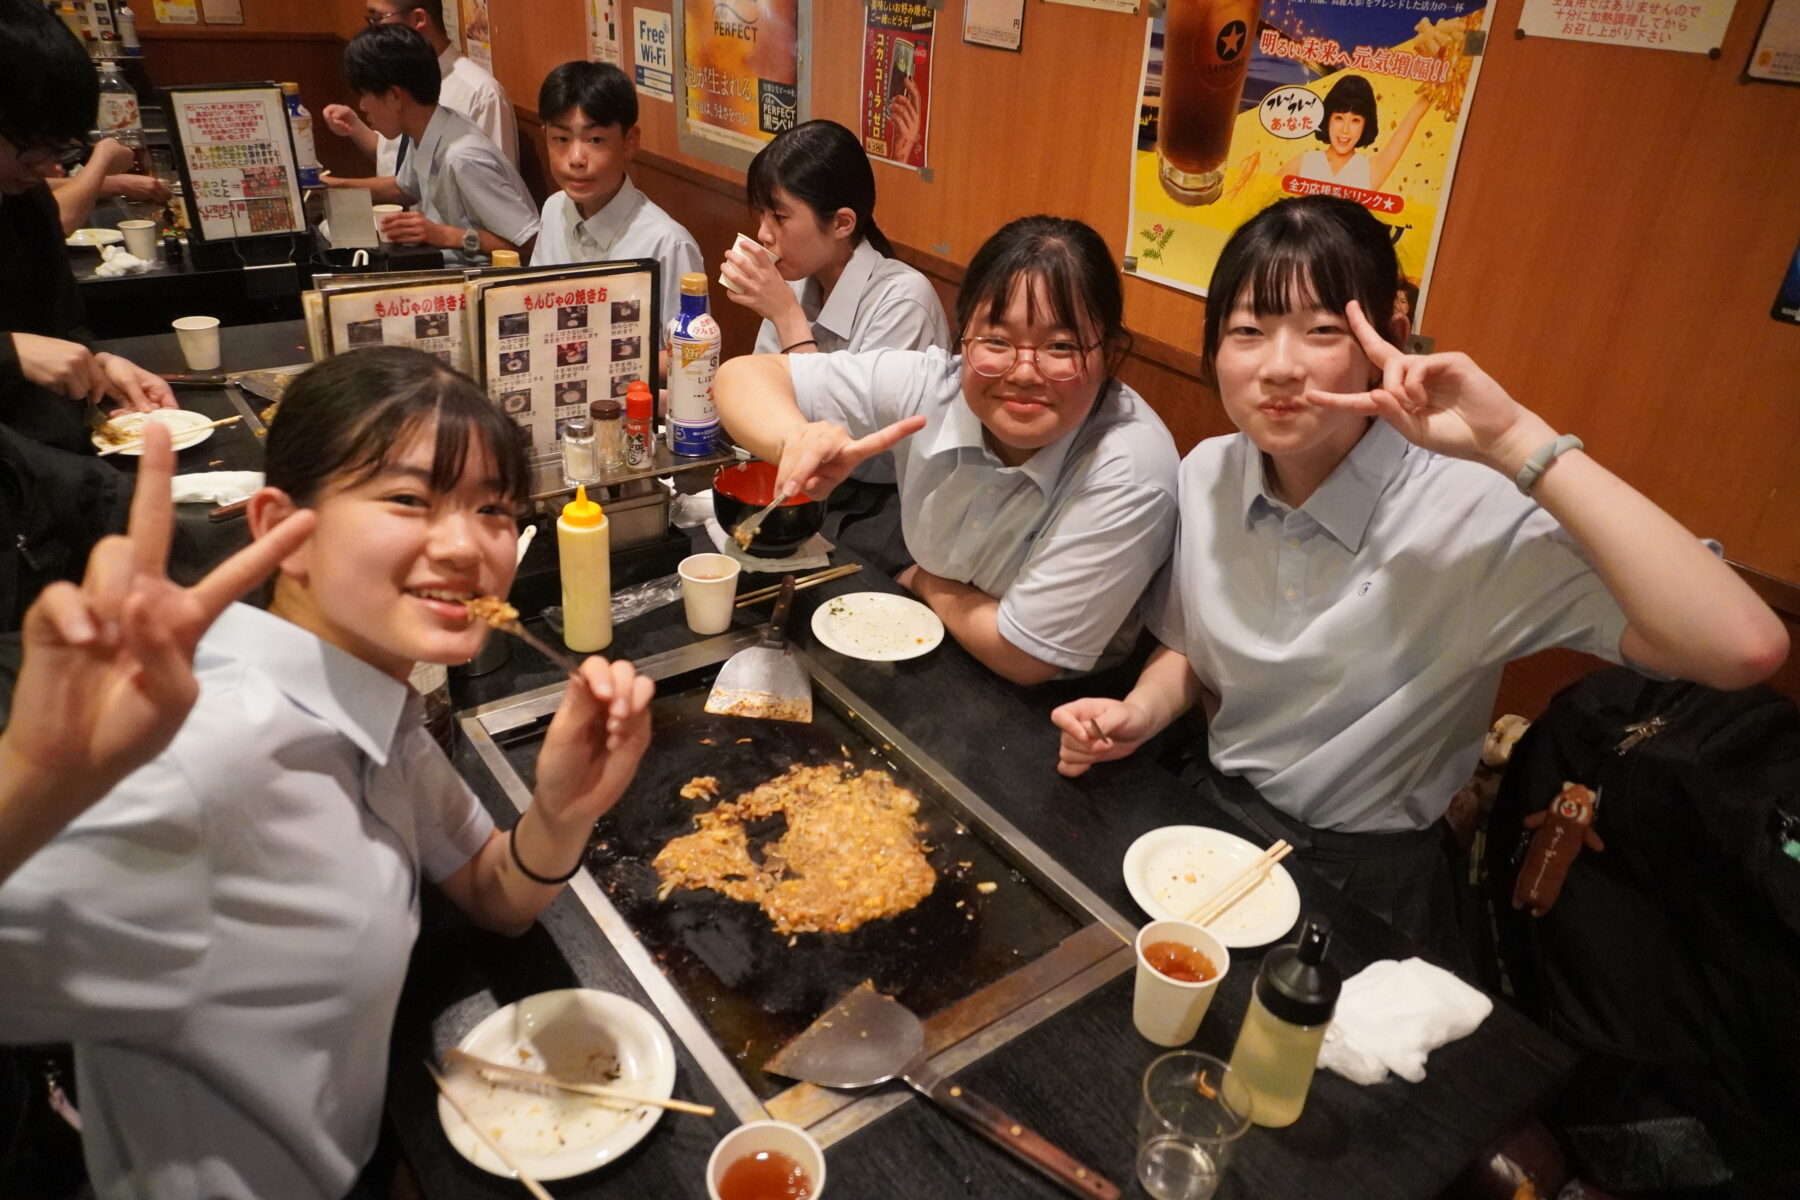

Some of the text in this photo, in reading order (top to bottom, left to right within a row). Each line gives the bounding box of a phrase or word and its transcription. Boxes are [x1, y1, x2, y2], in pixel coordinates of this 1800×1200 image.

[640, 20, 665, 45] Free
[714, 21, 758, 42] PERFECT
[1554, 10, 1687, 32] 十分に加熱調理してから
[1561, 22, 1672, 43] お召し上がり下さい
[640, 43, 666, 66] Wi-Fi
[1259, 28, 1450, 83] 明るい未来へ元気増幅!!
[873, 34, 884, 138] コカ・コーラ ゼロ
[763, 104, 796, 120] PERFECT
[524, 287, 608, 311] もんじゃの焼き方
